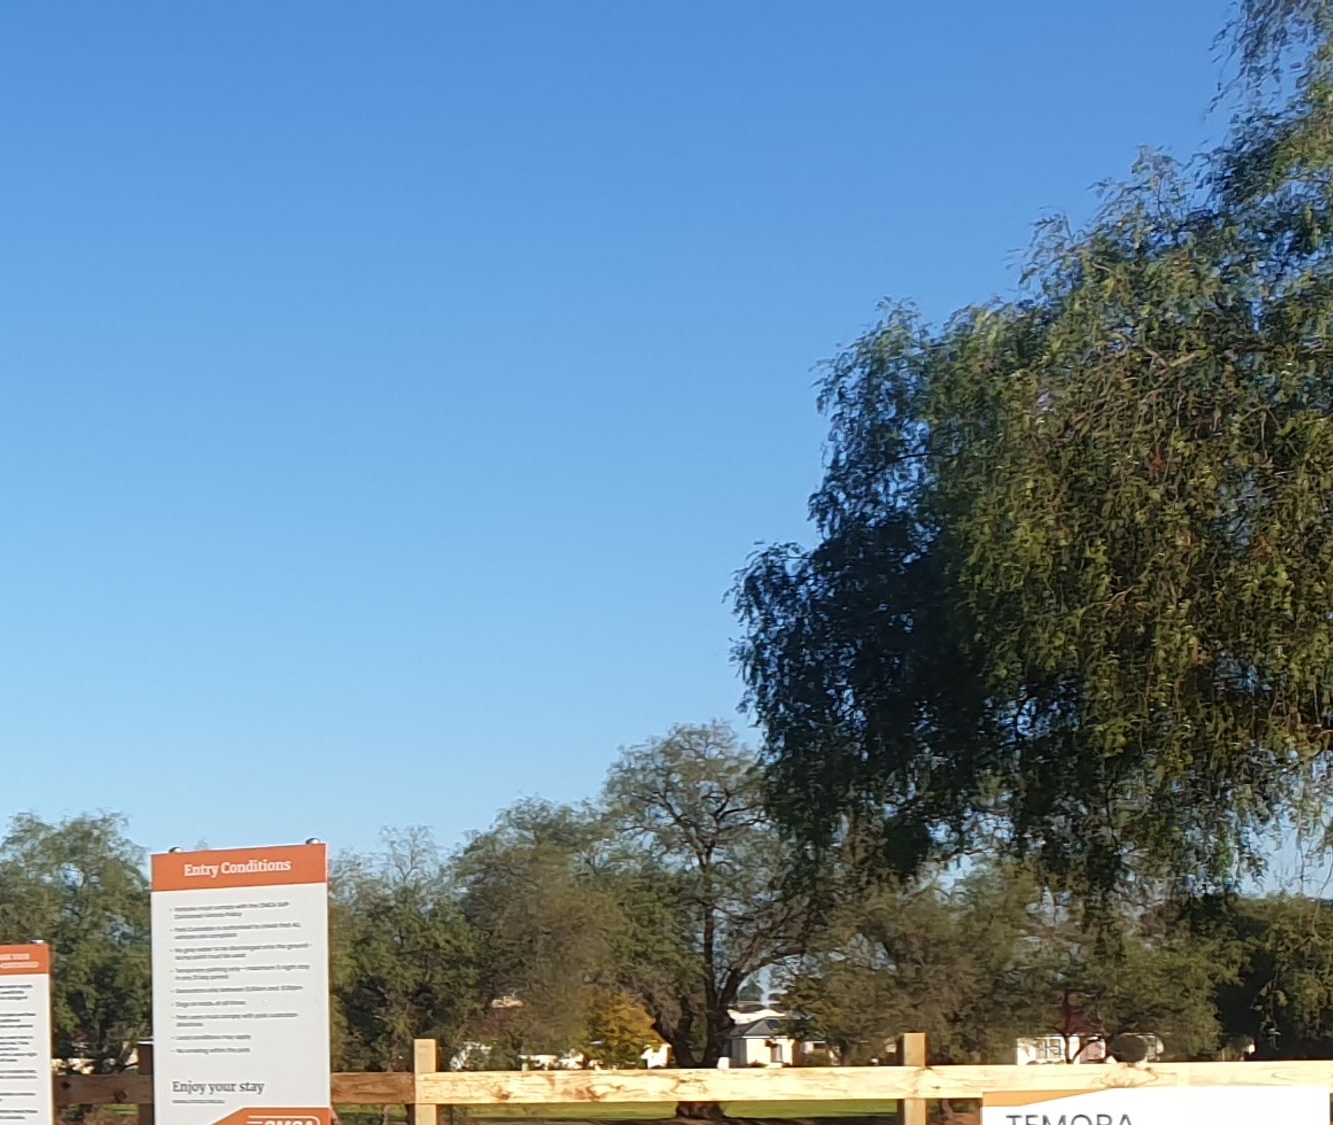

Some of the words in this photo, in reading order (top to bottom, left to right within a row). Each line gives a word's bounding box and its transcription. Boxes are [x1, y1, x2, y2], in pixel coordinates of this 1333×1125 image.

[183, 864, 219, 878] Entry
[221, 859, 292, 874] Conditions
[172, 1080, 206, 1095] Enjoy
[207, 1083, 236, 1095] your
[239, 1082, 265, 1095] stay
